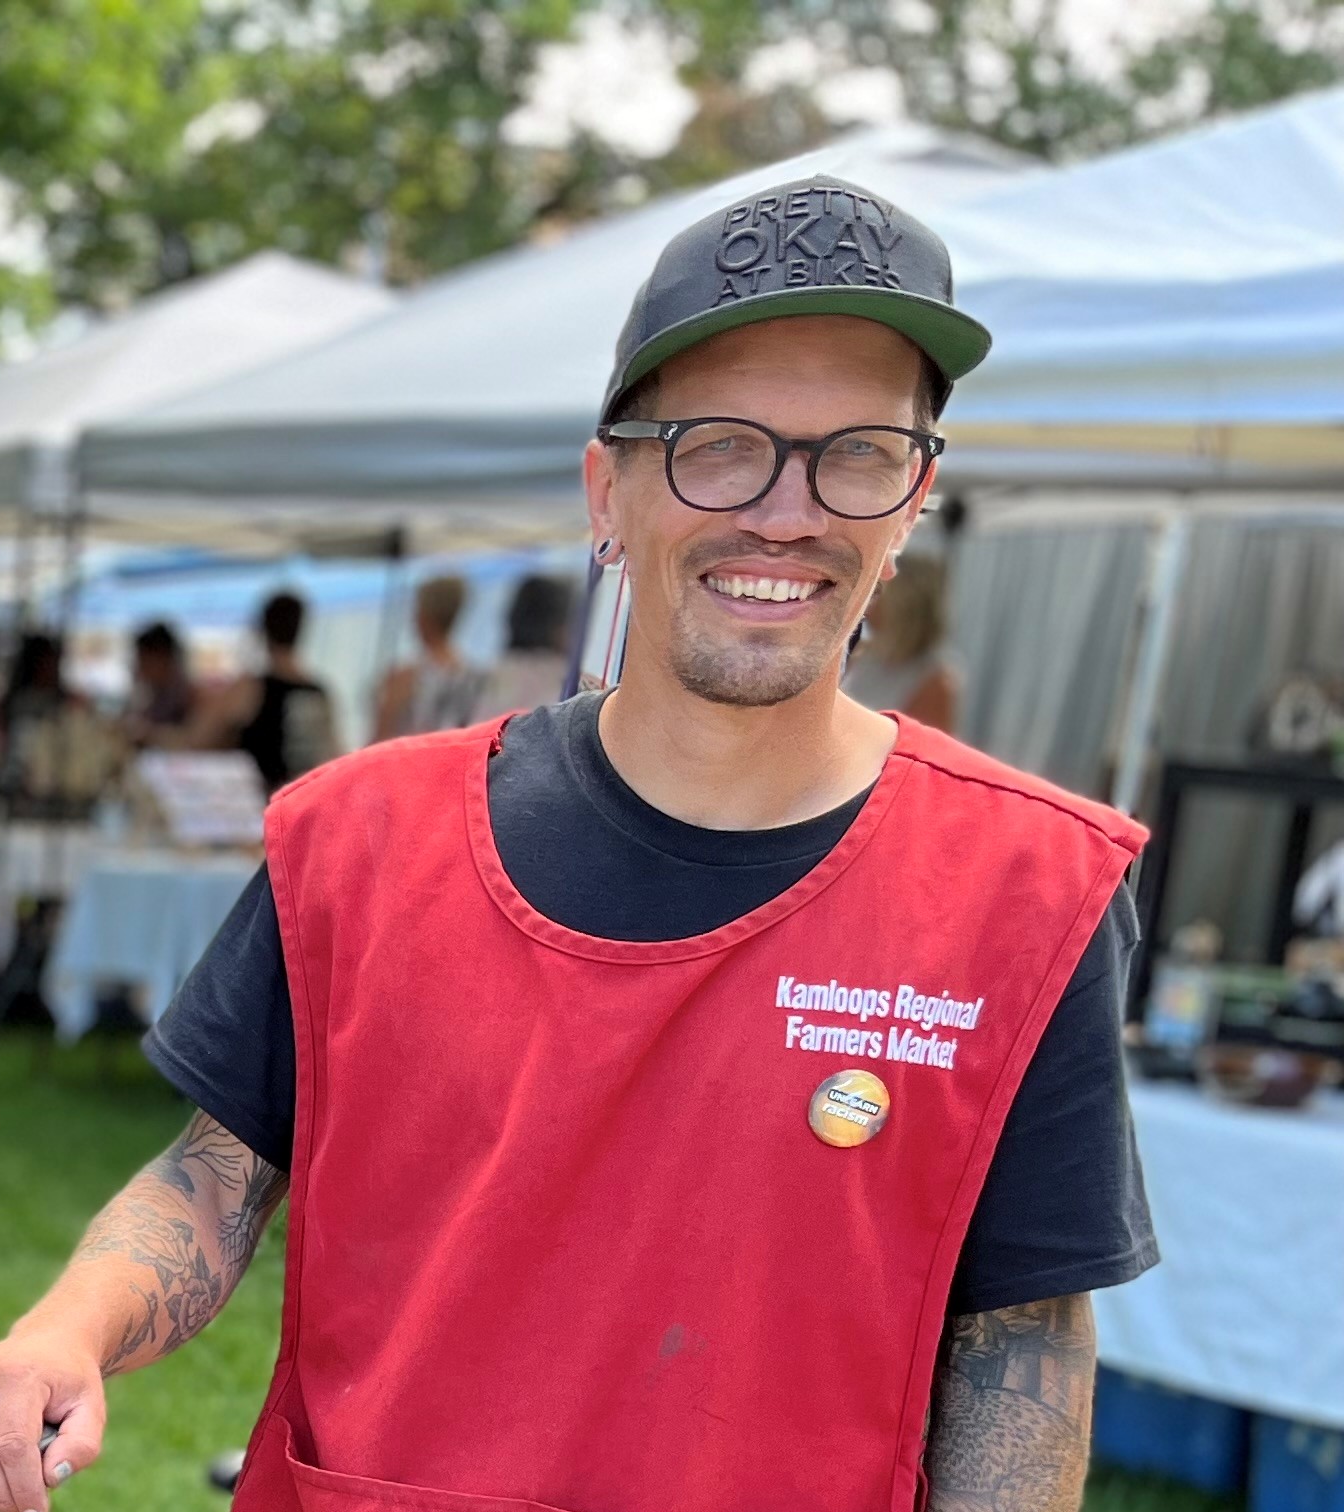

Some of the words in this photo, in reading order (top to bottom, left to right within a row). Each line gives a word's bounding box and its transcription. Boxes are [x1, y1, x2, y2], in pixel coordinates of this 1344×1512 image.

[722, 187, 894, 236] PRETTY
[715, 216, 903, 273] OKAY
[710, 264, 771, 308] AT
[785, 258, 901, 290] BIKES
[775, 975, 891, 1022] Kamloops
[894, 984, 985, 1031] Regional
[785, 1015, 883, 1059] Farmers
[886, 1026, 958, 1071] Market
[822, 1103, 869, 1126] racism
[829, 1090, 879, 1115] UNEARN
